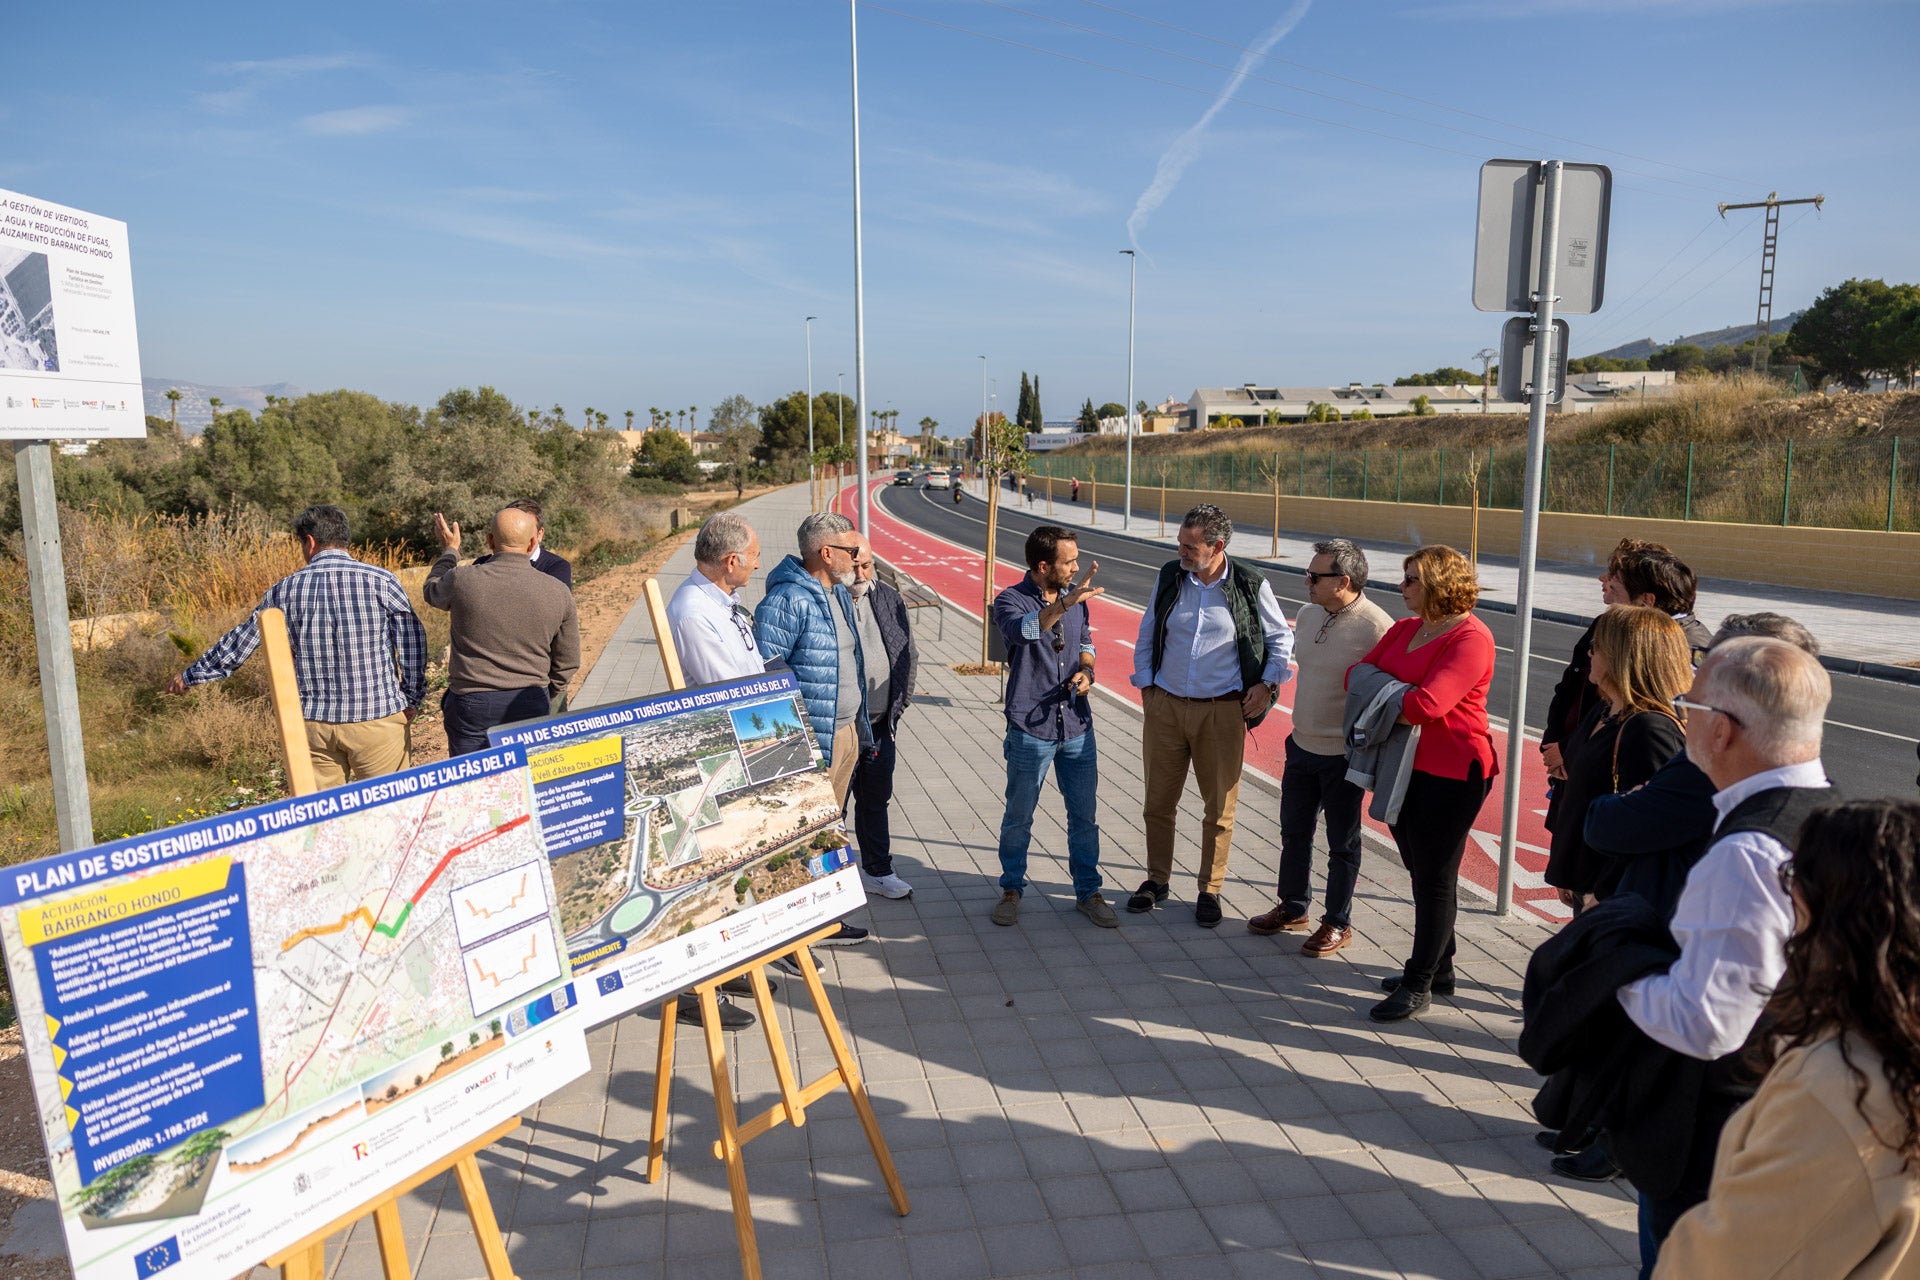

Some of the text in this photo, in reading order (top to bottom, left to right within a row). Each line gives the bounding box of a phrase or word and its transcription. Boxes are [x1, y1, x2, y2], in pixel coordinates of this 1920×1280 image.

[10, 200, 41, 216] GESTIÓN
[44, 210, 54, 219] DE
[55, 212, 89, 229] VERTIDOS,
[0, 227, 113, 260] AUZAMIENTO BARRANCO HONDO
[5, 215, 110, 248] AGUA Y REDUCCIÓN DE FUGAS,
[534, 726, 552, 743] DE
[552, 710, 634, 738] SOSTENIBILIDAD
[634, 700, 683, 720] TURÍSTICA
[683, 698, 694, 710] EN
[694, 689, 730, 708] DESTINO
[730, 687, 742, 698] DE
[742, 680, 769, 697] L'ALFÀS
[769, 678, 782, 692] DEL
[782, 678, 791, 688] PI
[536, 770, 551, 780] Vell
[552, 766, 576, 776] d'Altea
[594, 752, 618, 766] CV-753
[16, 750, 517, 896] PLAN DE SOSTENIBILIDAD TURÍSTICA EN DESTINO DE L'ALFÀS DEL PI
[41, 894, 108, 920] ACTUACIÓN
[43, 886, 182, 937] BARRANCO HONDO
[92, 1136, 155, 1172] INVERSIÓN:
